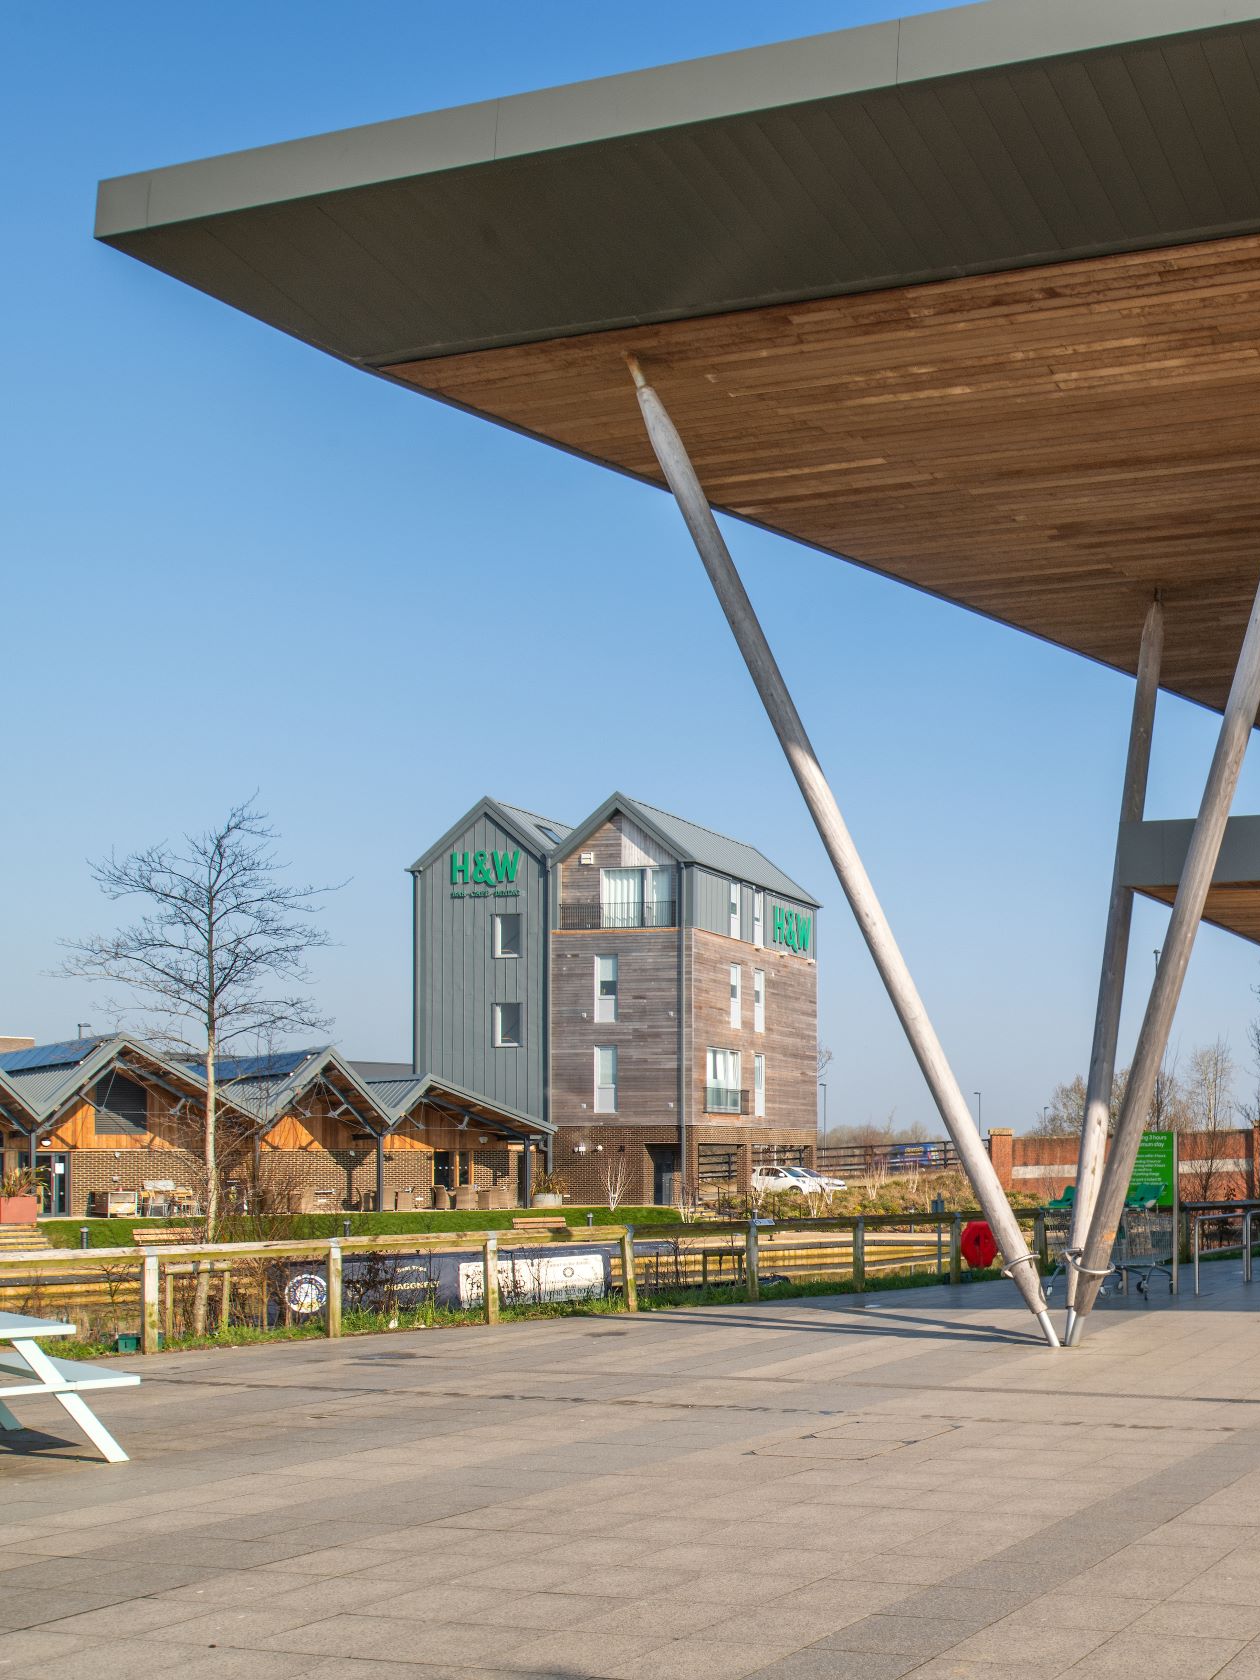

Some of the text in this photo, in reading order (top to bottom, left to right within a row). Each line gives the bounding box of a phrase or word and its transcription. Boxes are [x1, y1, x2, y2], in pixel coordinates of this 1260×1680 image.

[451, 850, 520, 887] H&W
[773, 905, 812, 953] H&W
[384, 1281, 440, 1291] DRAGONFLY
